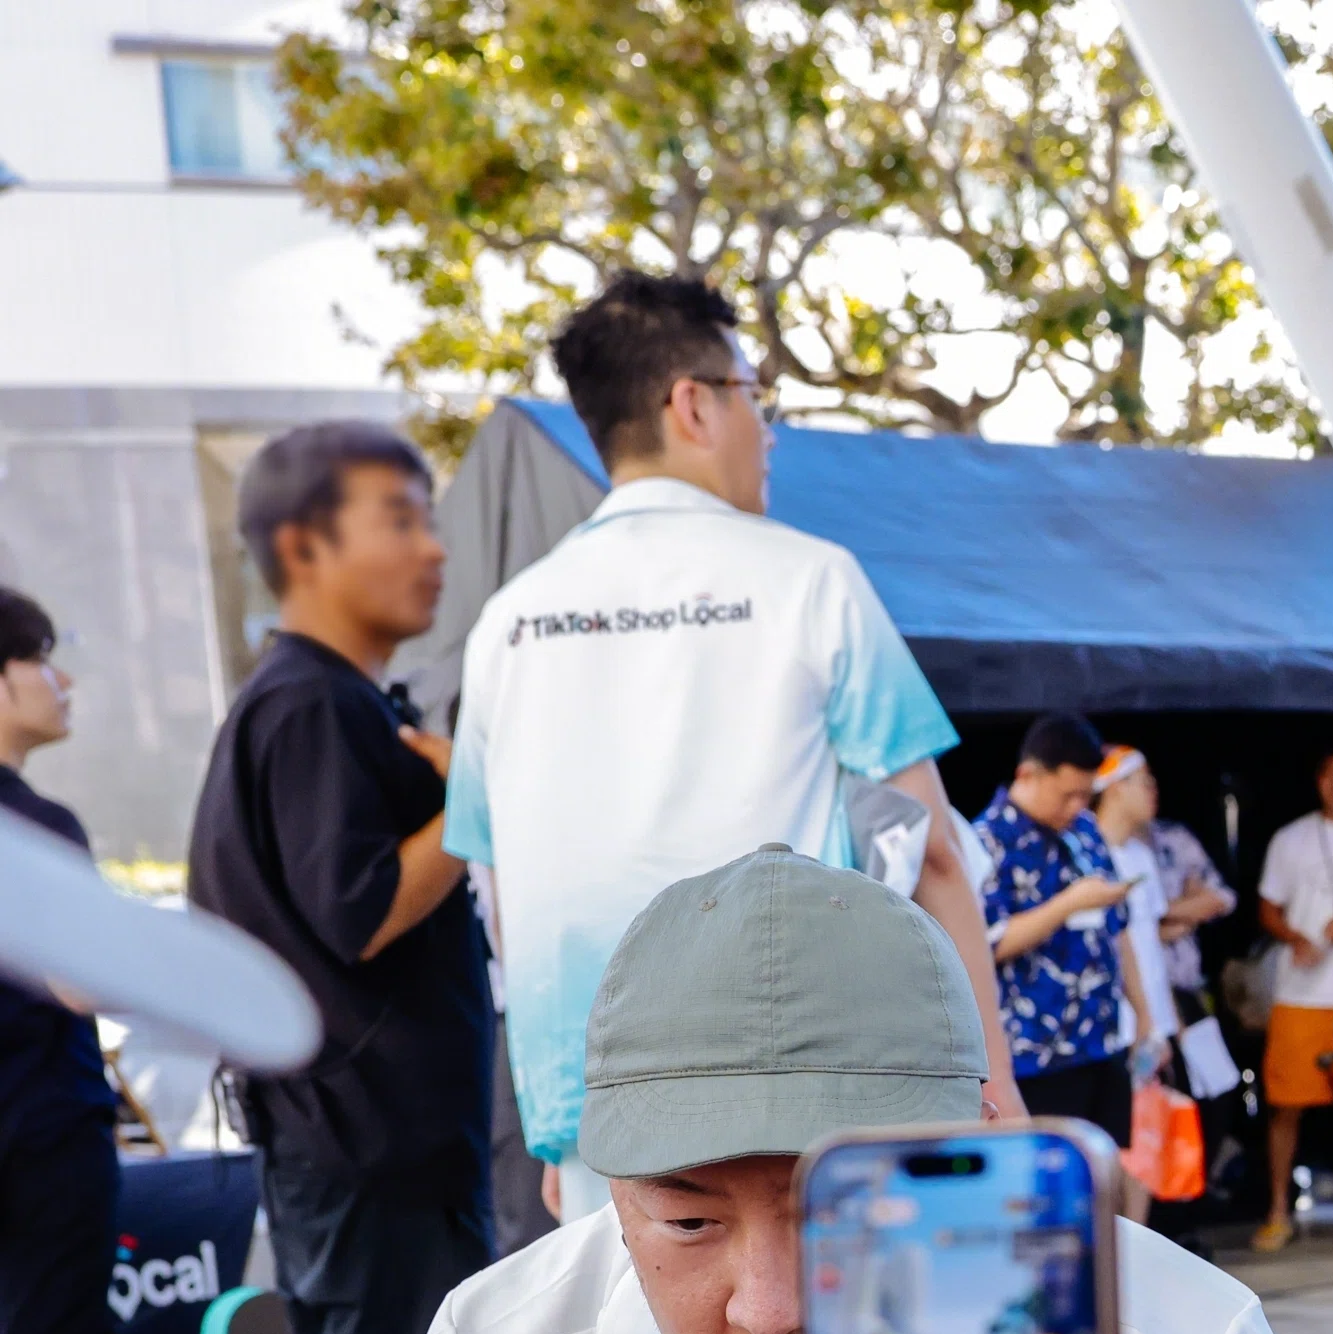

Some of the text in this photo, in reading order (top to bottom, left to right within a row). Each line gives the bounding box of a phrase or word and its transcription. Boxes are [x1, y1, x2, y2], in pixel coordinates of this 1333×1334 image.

[531, 597, 753, 639] TikTok Shop Local
[107, 1238, 220, 1322] ocal
